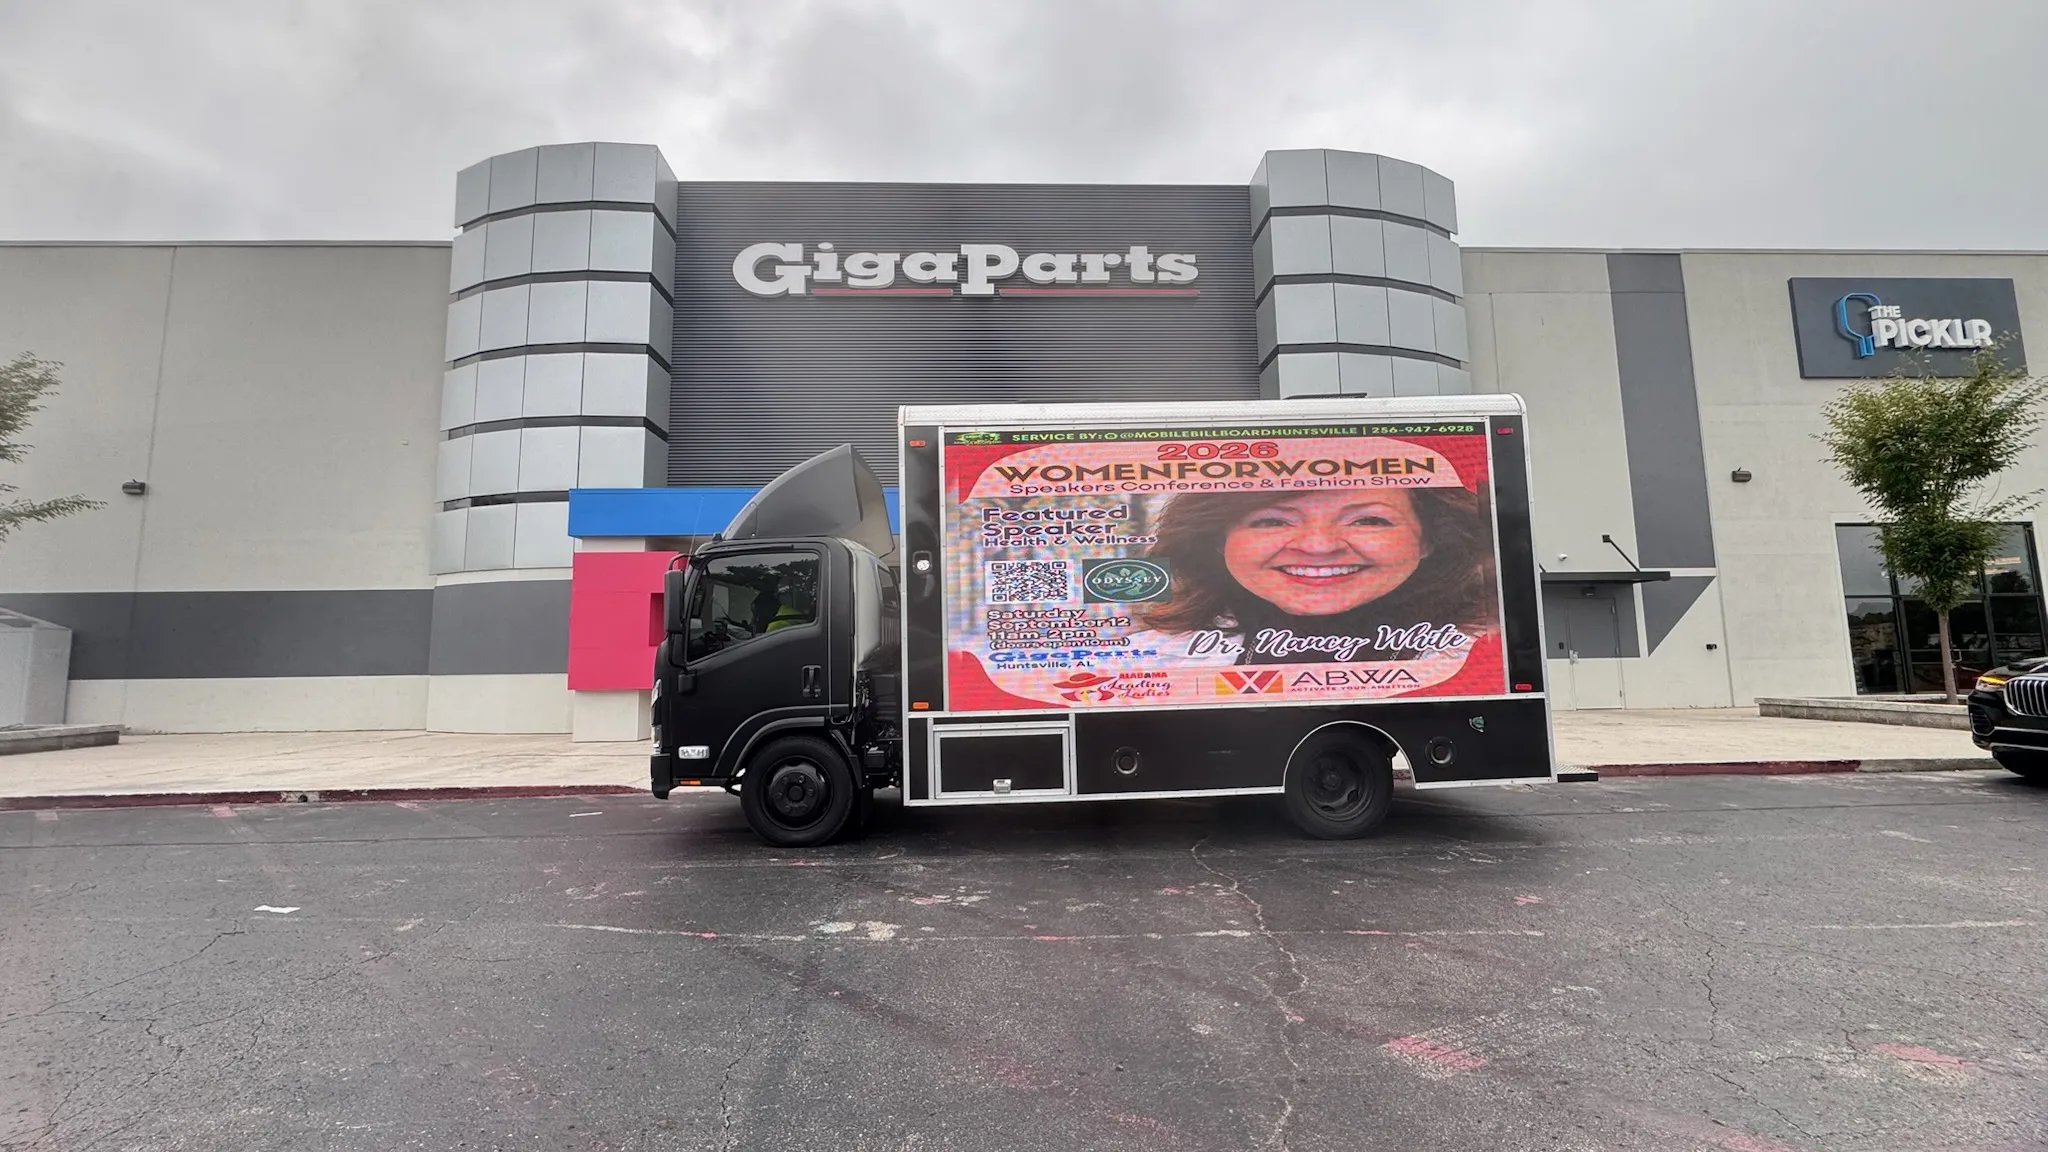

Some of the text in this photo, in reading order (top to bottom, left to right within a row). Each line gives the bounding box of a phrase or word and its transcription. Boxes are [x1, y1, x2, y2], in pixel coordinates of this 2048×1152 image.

[732, 242, 1199, 295] GigaParts
[1868, 305, 1901, 318] THE
[1871, 318, 1993, 348] PICKLR
[1012, 433, 1075, 442] SERVICE
[1079, 432, 1102, 441] BY:
[1120, 426, 1357, 440] @MOBILEBILLBOARDHUNTSVILLE
[1371, 425, 1474, 434] 256-947-6928
[1157, 442, 1279, 461] 2026
[994, 457, 1435, 483] WOMENFORWOMEN
[1010, 475, 1431, 495] Speakers Conference & Fashion Show
[982, 505, 1128, 522] Featured
[983, 521, 1117, 539] Speaker
[984, 535, 1157, 546] Health & Wellness
[1092, 575, 1161, 584] ODYSSEY
[987, 608, 1086, 620] Saturday
[988, 617, 1130, 632] September 12
[989, 637, 1131, 650] (doors open 10am)
[1187, 622, 1468, 661] Dr. Nancy White
[988, 649, 1158, 663] GigaParts
[996, 662, 1071, 670] Huntsville,
[1107, 680, 1171, 690] Leading
[1291, 669, 1418, 686] ABWA
